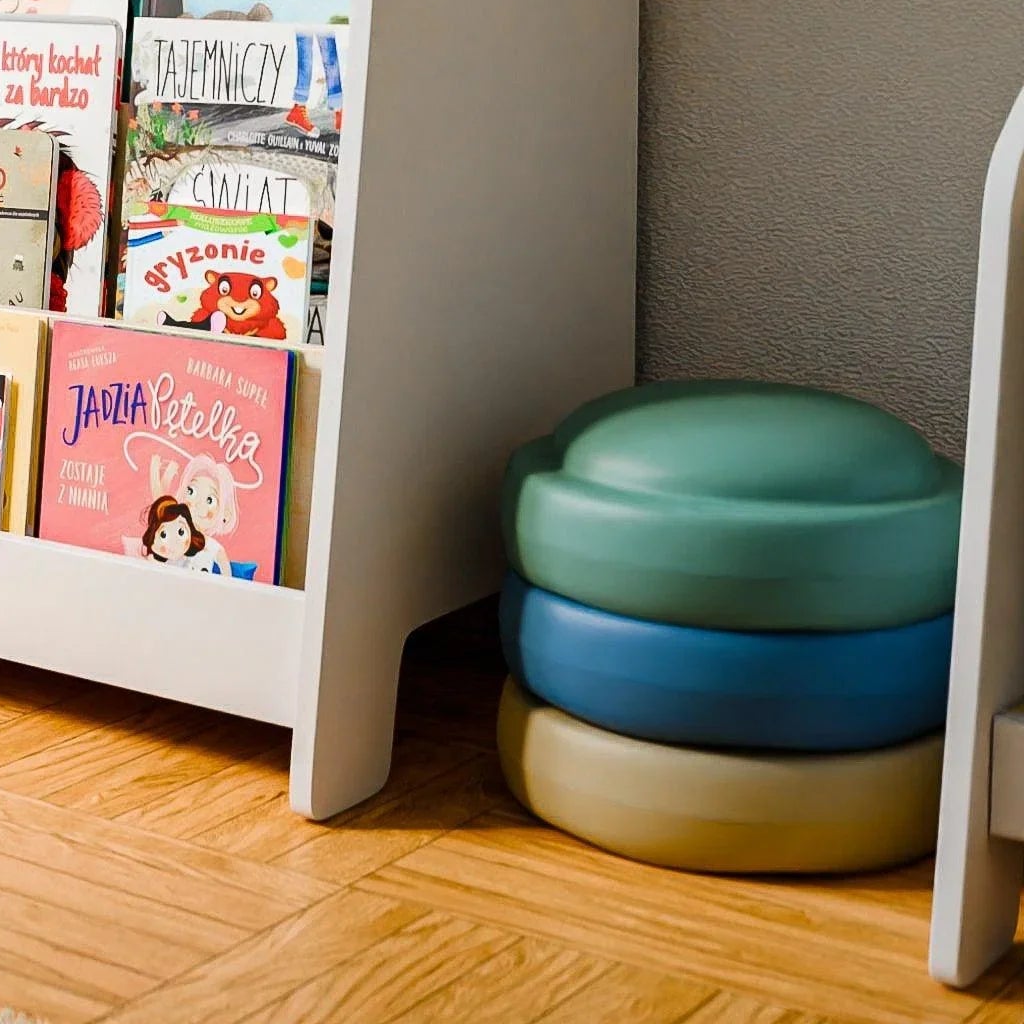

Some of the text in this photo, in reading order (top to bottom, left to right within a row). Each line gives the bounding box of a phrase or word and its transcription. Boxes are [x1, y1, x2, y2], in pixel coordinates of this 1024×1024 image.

[1, 41, 43, 84] który
[48, 43, 102, 77] kochał
[4, 74, 89, 109] za bardzo
[144, 240, 265, 293] gryzonie
[186, 357, 233, 389] BARBARA
[147, 372, 262, 463] Pętelka
[59, 459, 105, 487] ZOSTAJE
[57, 484, 66, 505] Z
